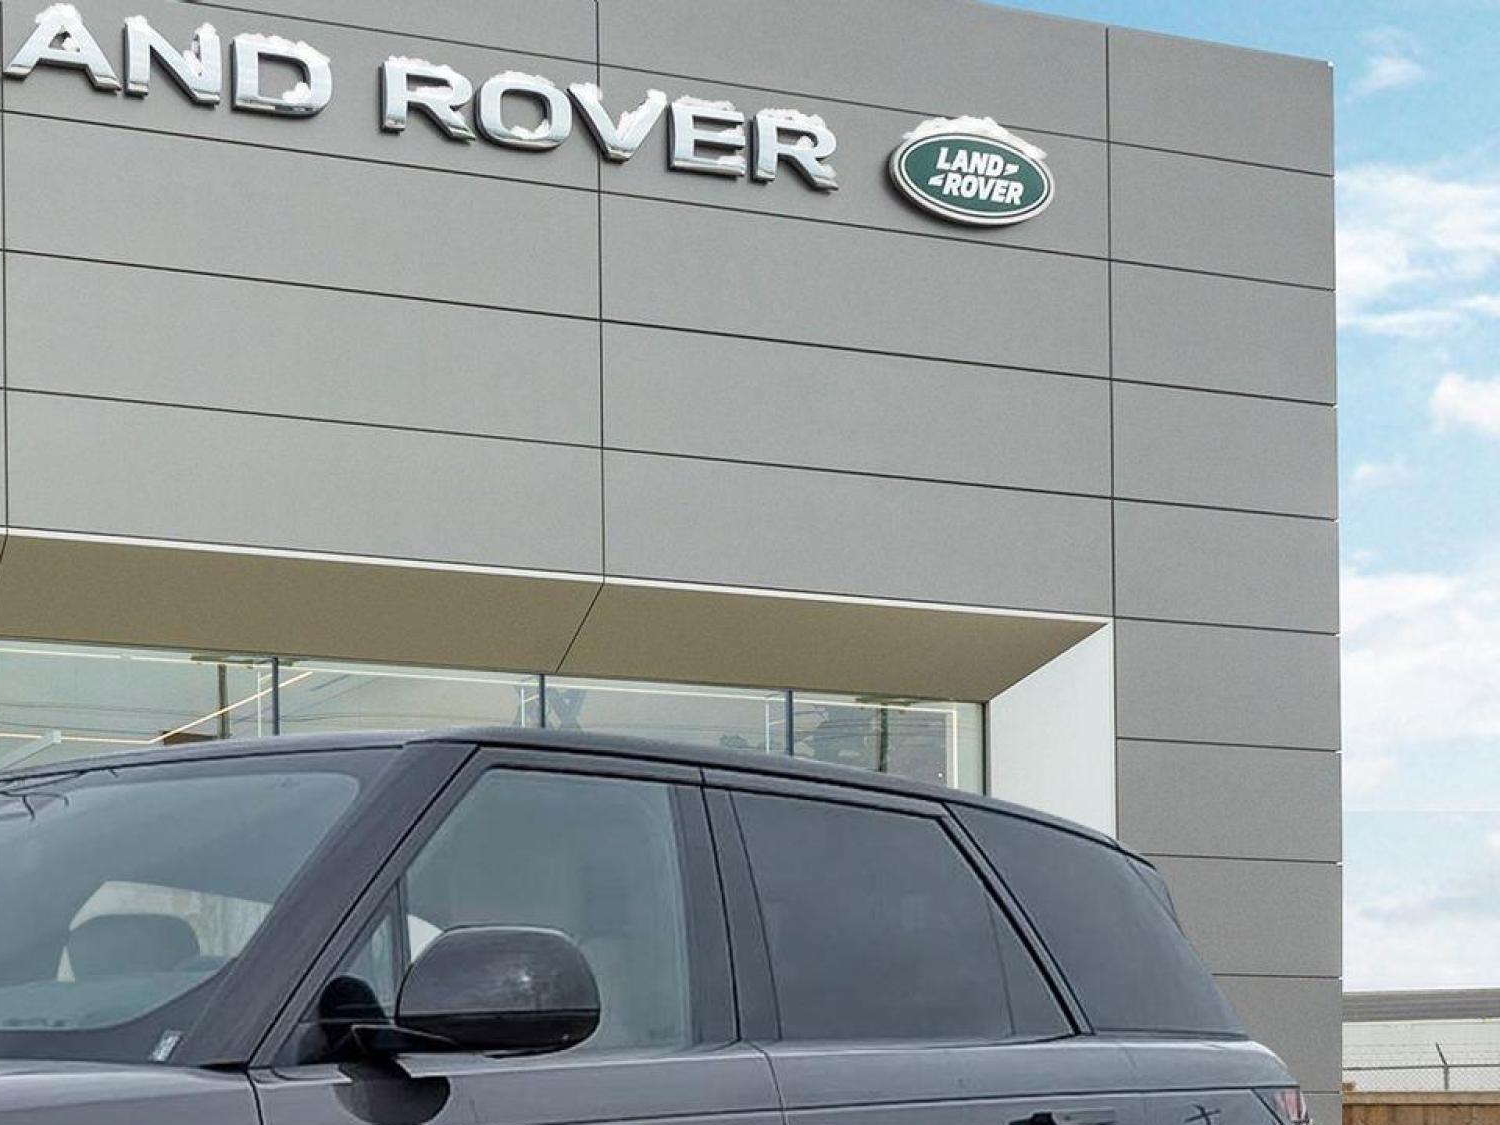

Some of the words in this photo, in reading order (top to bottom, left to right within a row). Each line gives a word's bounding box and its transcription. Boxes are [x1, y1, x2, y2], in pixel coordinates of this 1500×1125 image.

[378, 56, 839, 192] ROVER
[936, 147, 1004, 177] LAND
[942, 172, 1025, 205] ROVER
